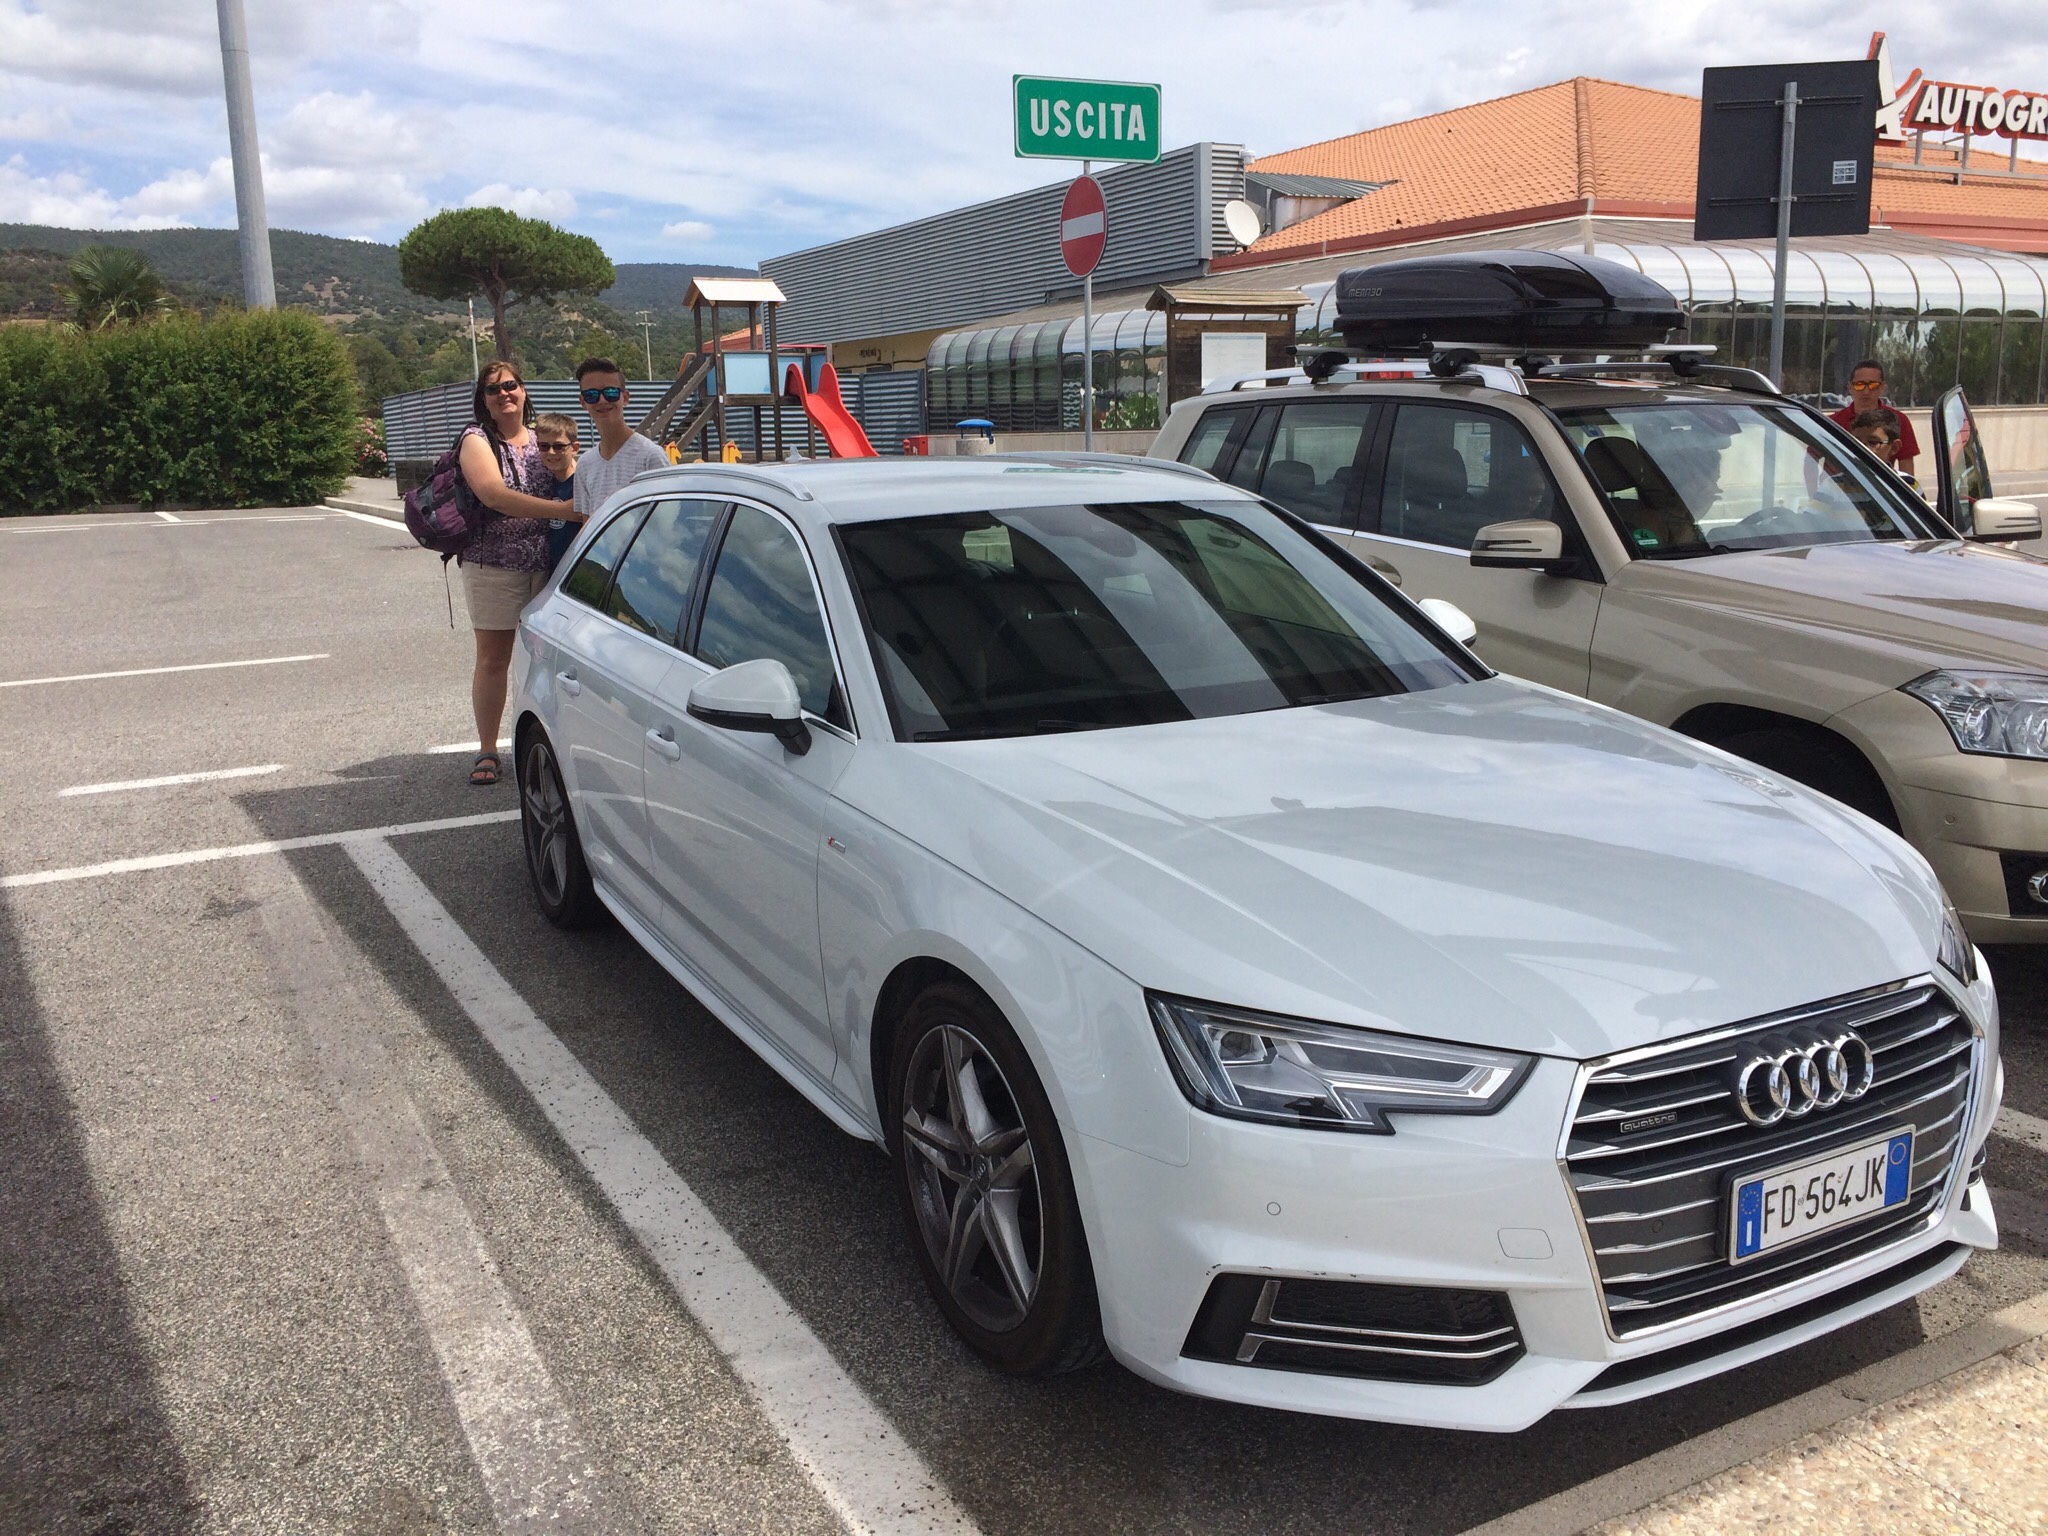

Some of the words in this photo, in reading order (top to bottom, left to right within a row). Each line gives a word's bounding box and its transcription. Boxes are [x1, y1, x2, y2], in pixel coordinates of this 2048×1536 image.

[1030, 98, 1146, 141] USCITA
[1623, 1113, 1676, 1131] quattro
[1763, 1183, 1797, 1234] FD
